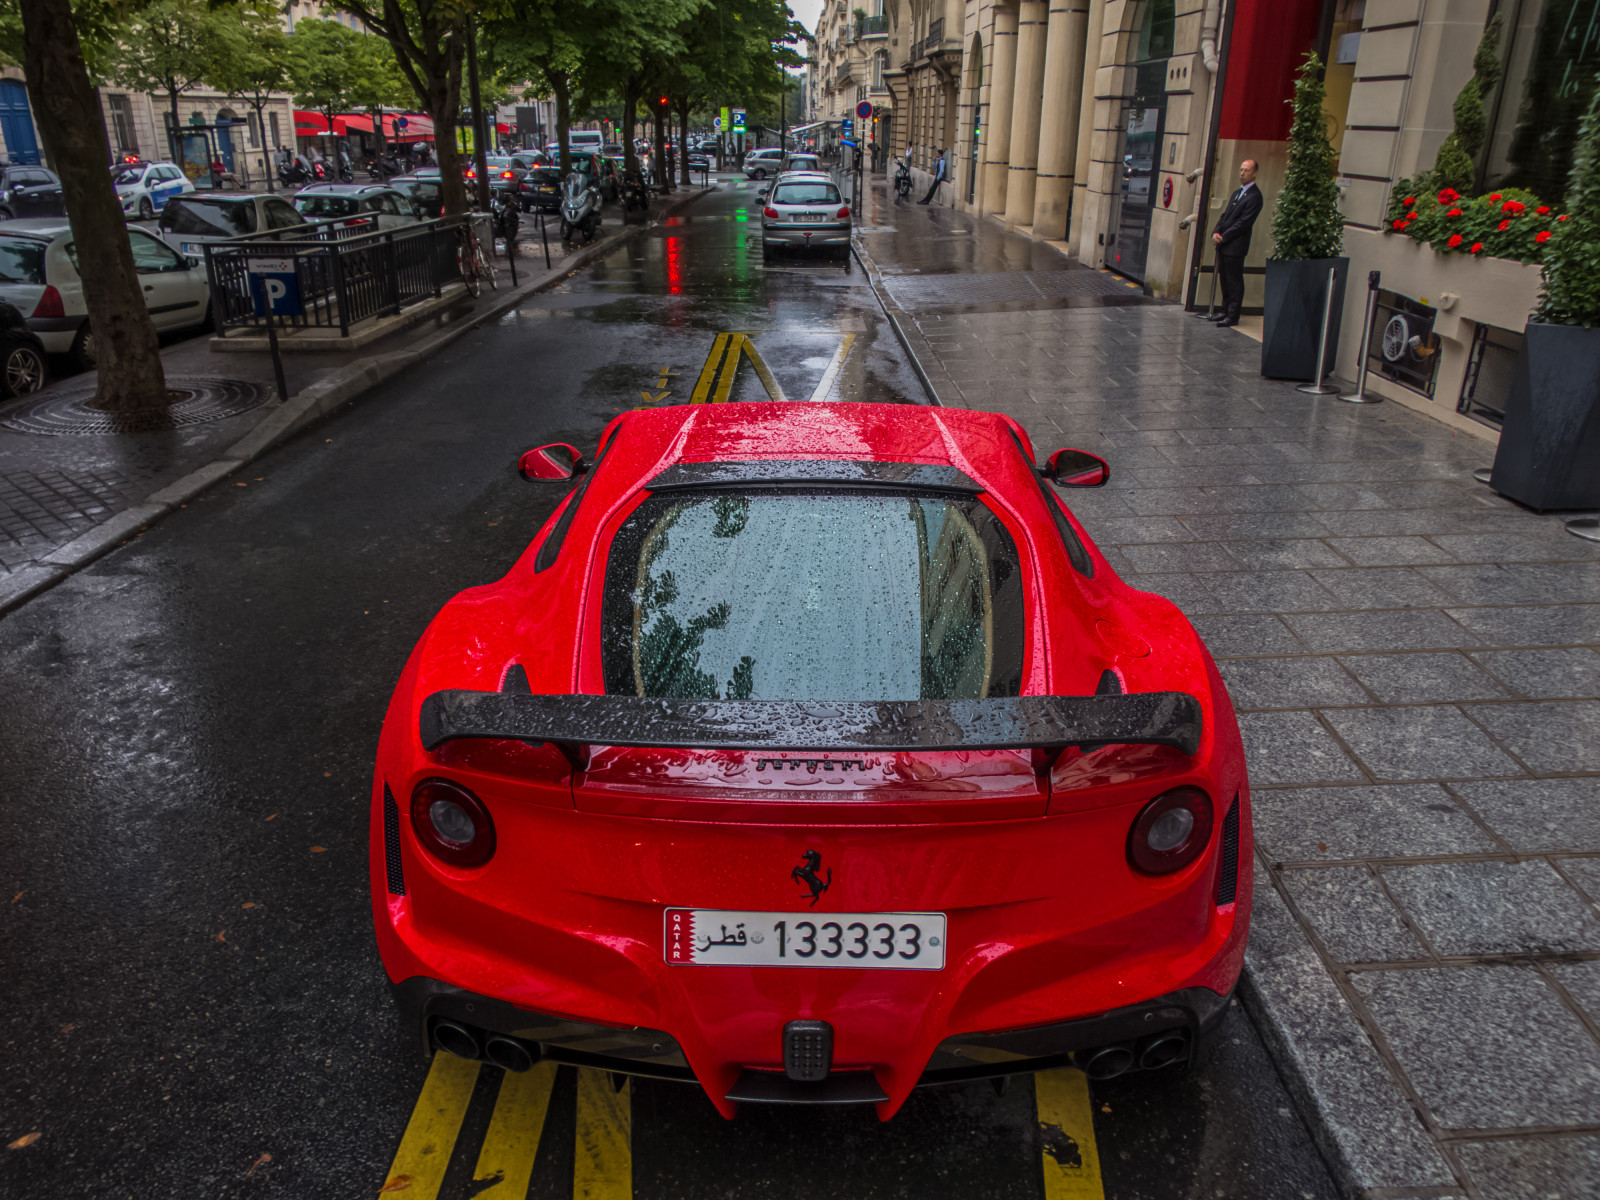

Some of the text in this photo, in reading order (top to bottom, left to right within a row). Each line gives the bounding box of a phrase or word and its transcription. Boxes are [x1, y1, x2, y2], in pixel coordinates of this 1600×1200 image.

[264, 279, 286, 309] P
[672, 914, 682, 959] QATAR
[695, 922, 748, 952] قطر
[773, 920, 922, 960] 133333
